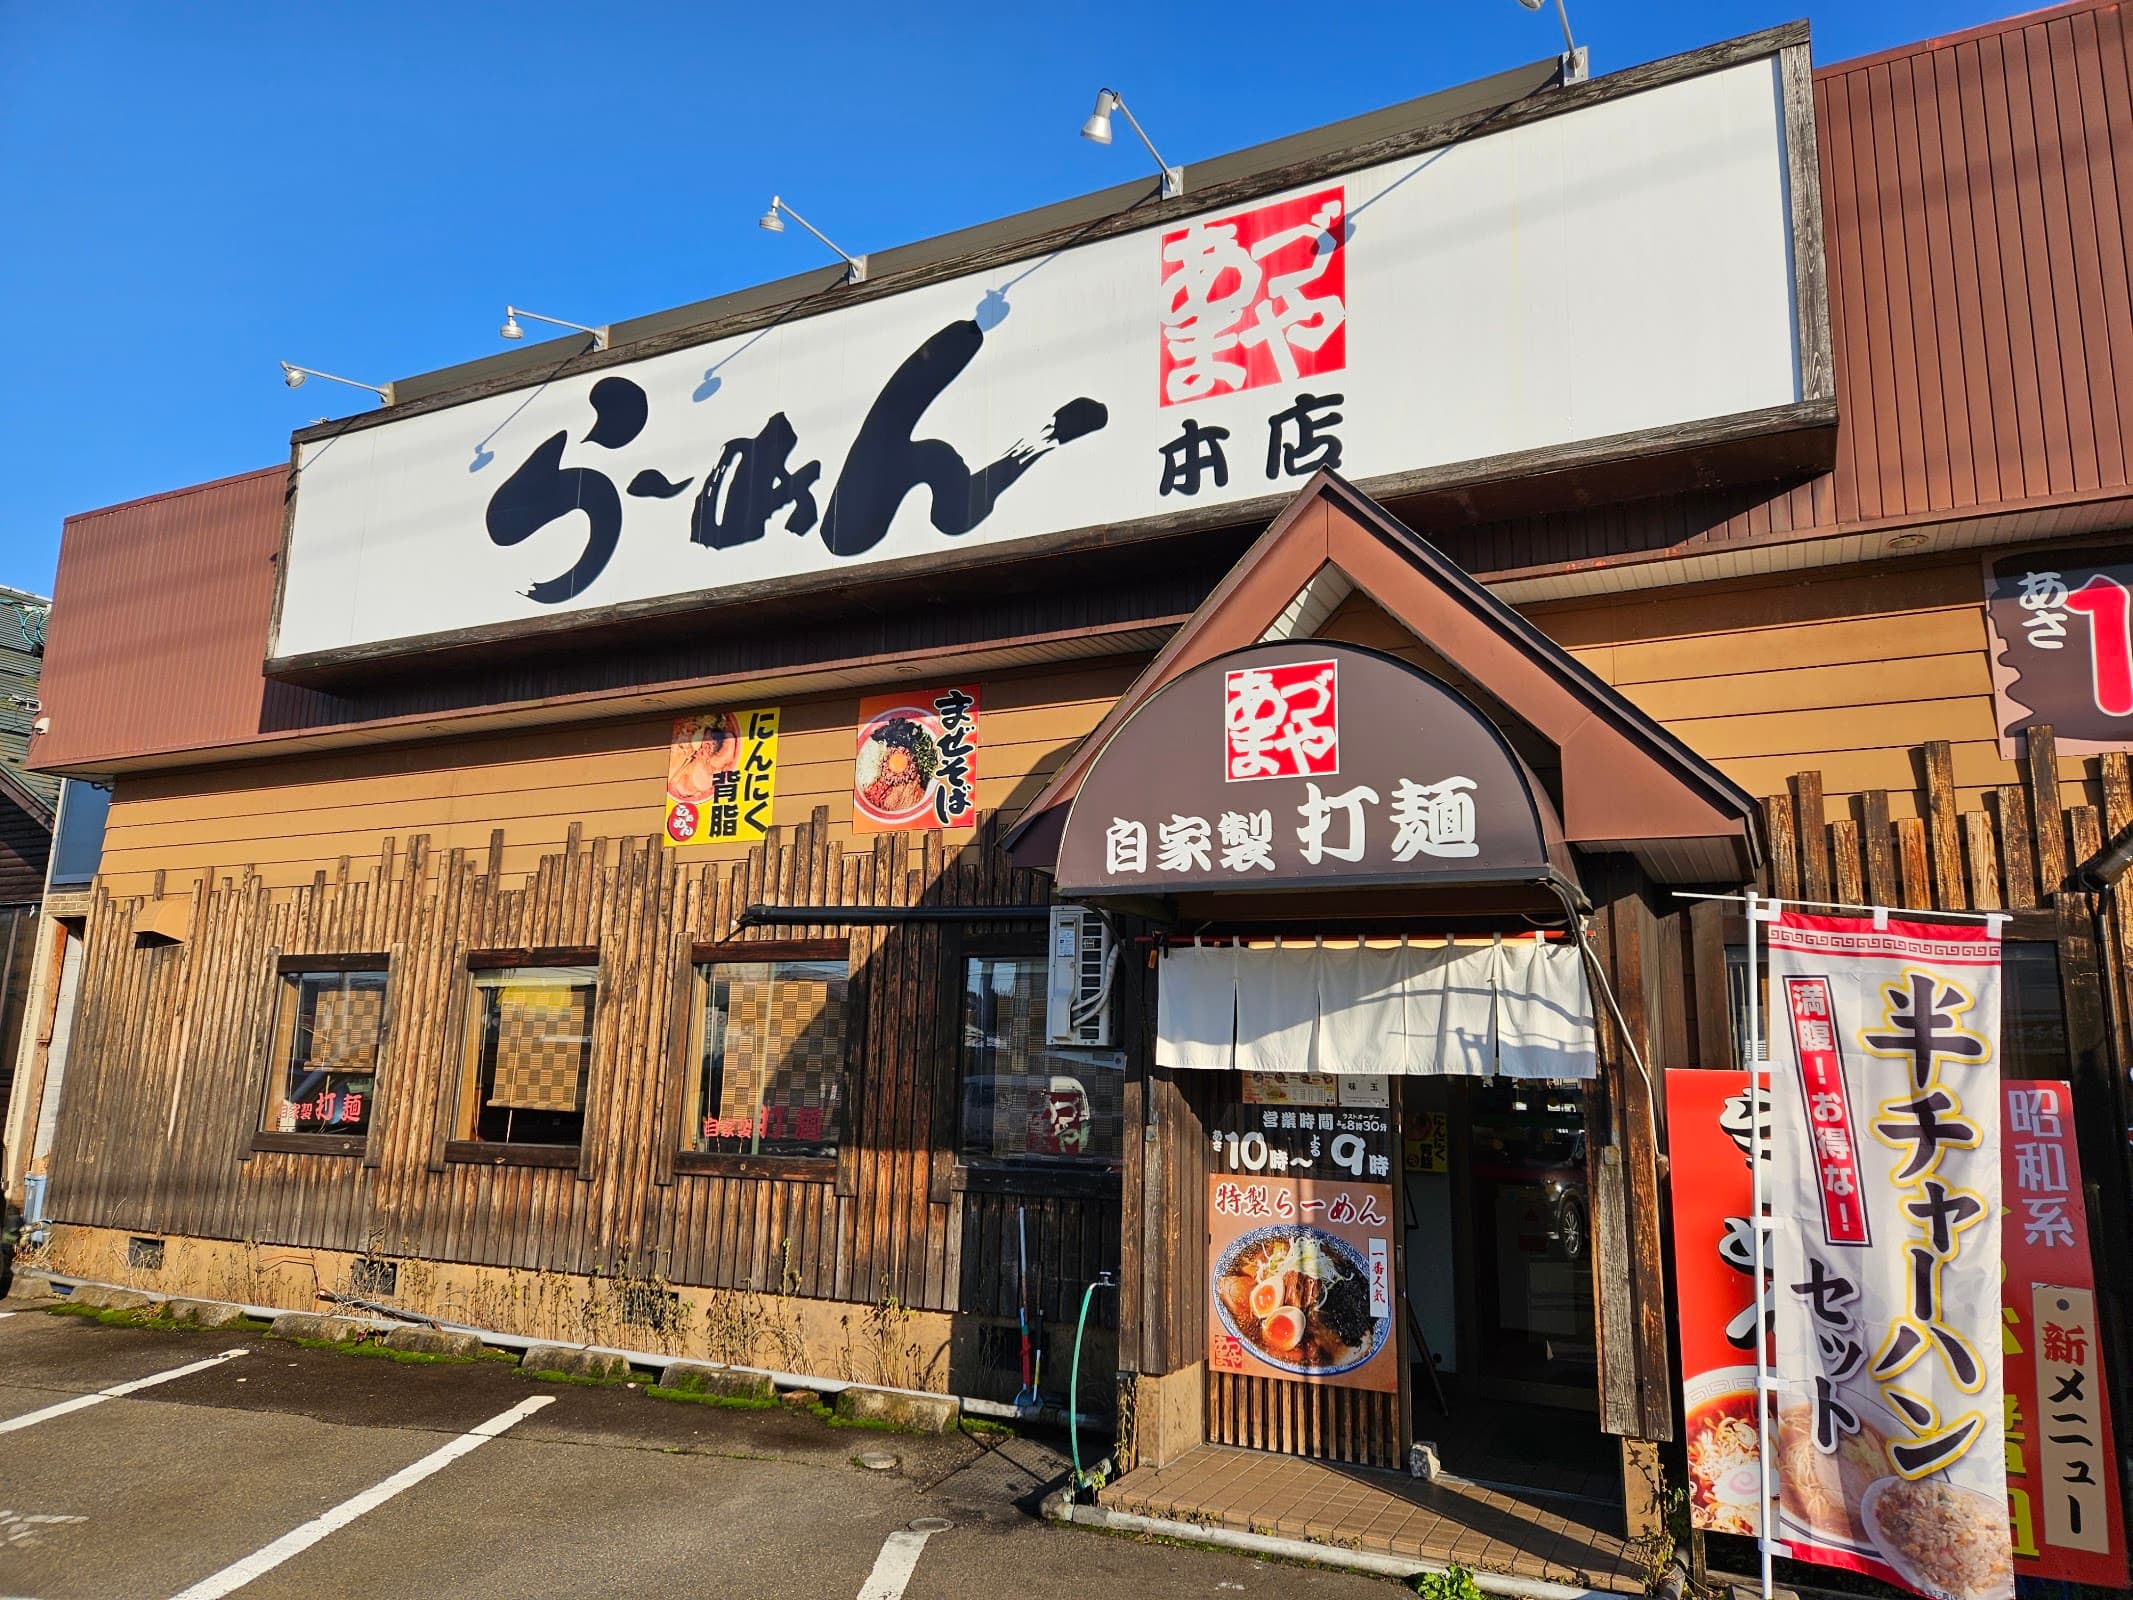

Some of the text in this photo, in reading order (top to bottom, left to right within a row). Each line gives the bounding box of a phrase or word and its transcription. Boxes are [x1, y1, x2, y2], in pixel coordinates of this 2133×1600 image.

[1161, 186, 1346, 408] あづまや
[486, 318, 1110, 606] らーめん
[1159, 393, 1345, 498] 本店
[2017, 571, 2070, 650] あさ
[743, 712, 774, 833] にんにく
[933, 689, 976, 826] まぜそば
[1226, 661, 1339, 781] あづまや
[709, 770, 741, 838] 背脂
[1262, 1110, 1334, 1131] 営業時間
[2007, 1088, 2076, 1248] 昭和系
[1215, 1183, 1387, 1226] 特製らーめん
[1865, 972, 1984, 1474] 半チャーハン
[1371, 1251, 1386, 1303] 一番人気
[1791, 1258, 1862, 1450] セット
[2043, 1320, 2097, 1534] 新メニュー
